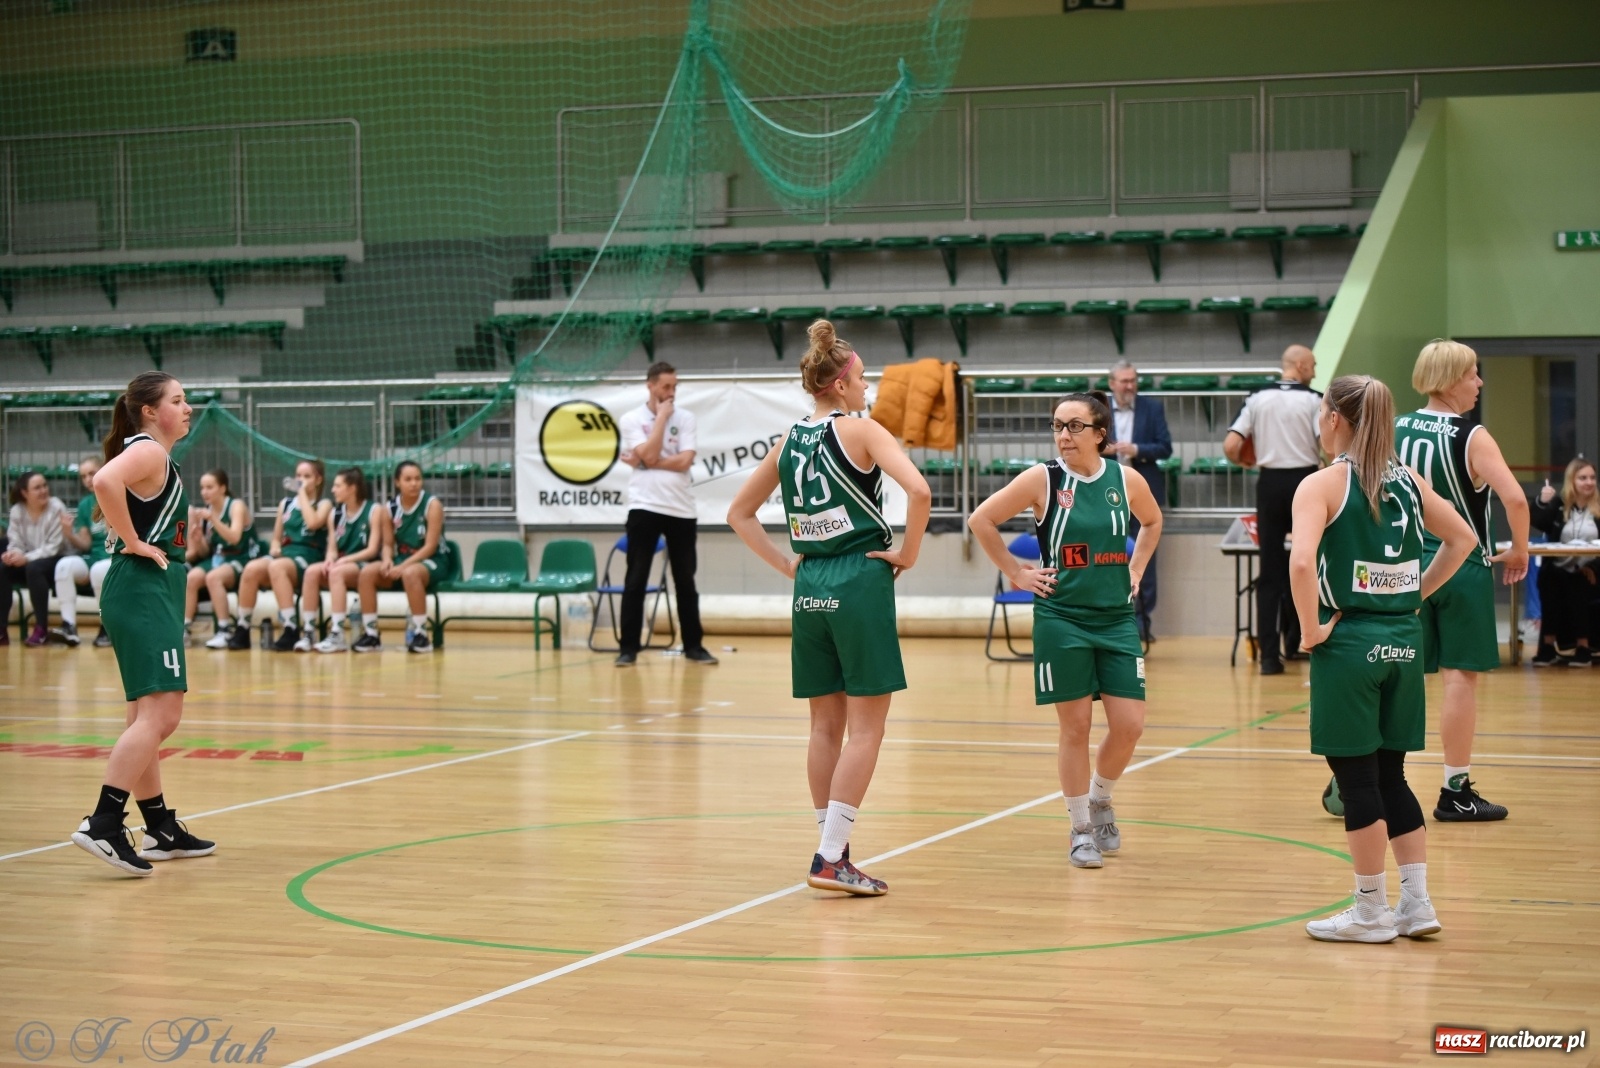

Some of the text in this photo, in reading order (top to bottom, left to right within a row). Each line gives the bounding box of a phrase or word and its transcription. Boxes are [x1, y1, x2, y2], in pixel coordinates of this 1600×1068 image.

[702, 452, 727, 477] W
[1400, 435, 1435, 490] 10
[539, 486, 624, 505] RACIBÓRZ
[1110, 510, 1126, 536] 11
[1381, 491, 1409, 557] 3
[1063, 547, 1087, 566] K
[1370, 573, 1418, 588] WAGTECH
[803, 597, 840, 609] Clavis
[163, 649, 181, 677] 4
[1381, 645, 1416, 659] Clavis
[1039, 662, 1054, 693] 11
